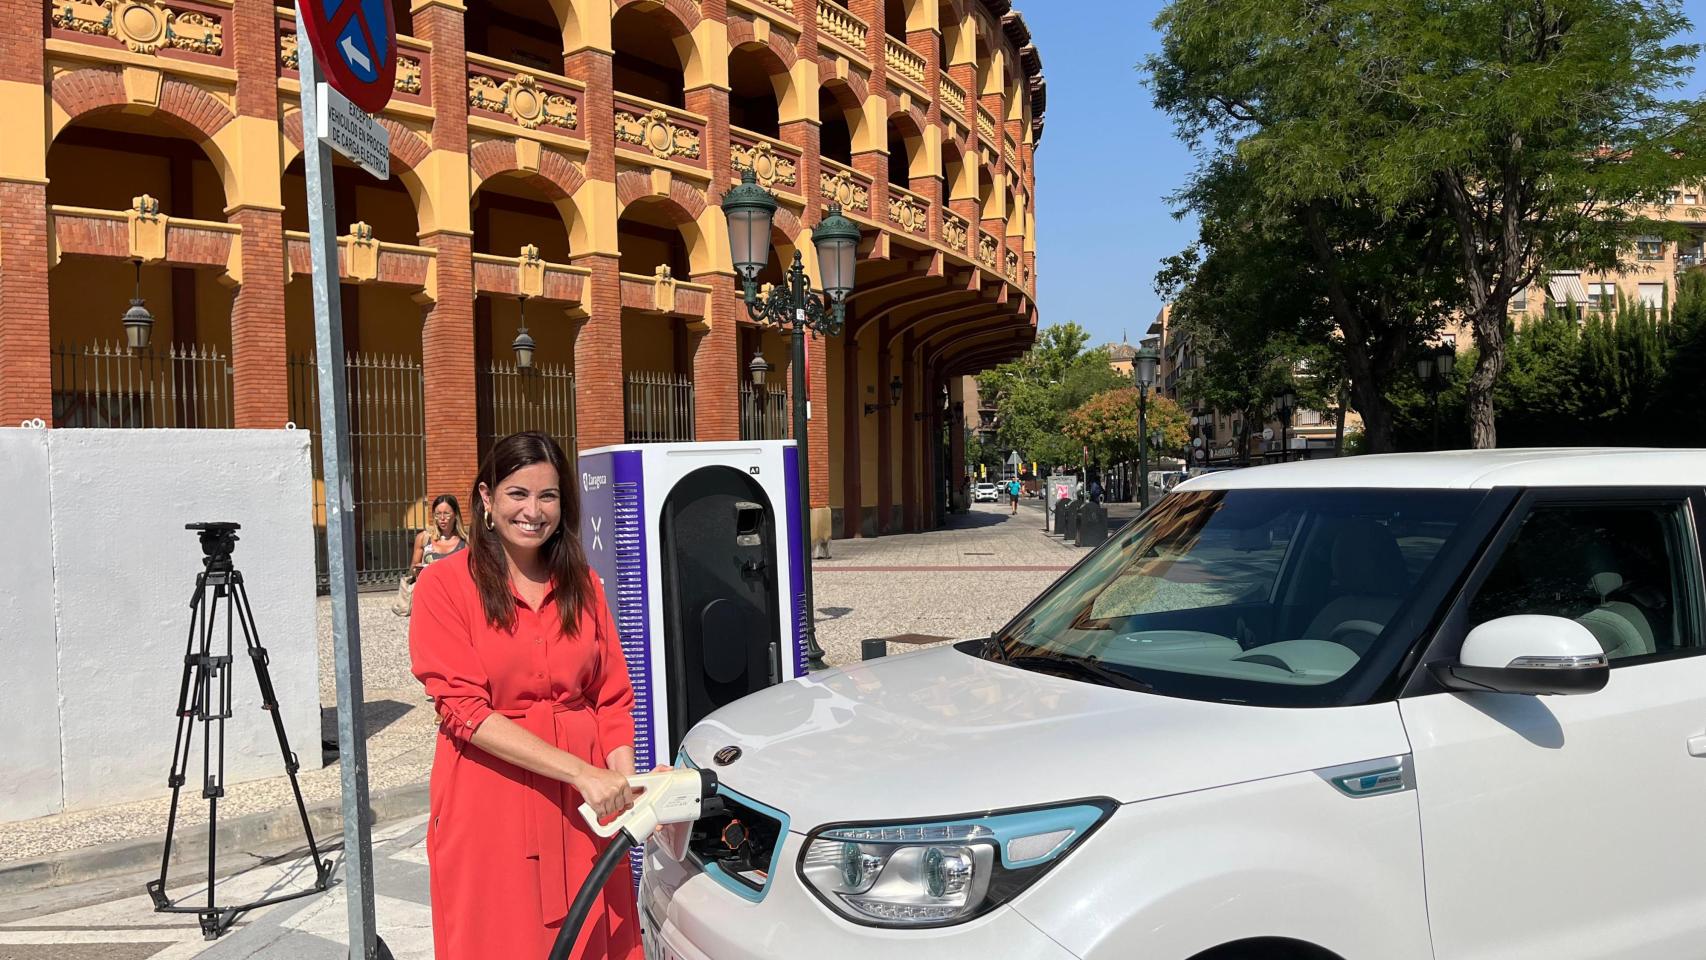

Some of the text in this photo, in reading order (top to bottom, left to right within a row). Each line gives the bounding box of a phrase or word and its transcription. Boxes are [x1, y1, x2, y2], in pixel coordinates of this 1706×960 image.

[332, 127, 341, 143] DE
[341, 133, 360, 154] CARGA
[358, 127, 366, 142] EN
[366, 132, 389, 160] PROCESO
